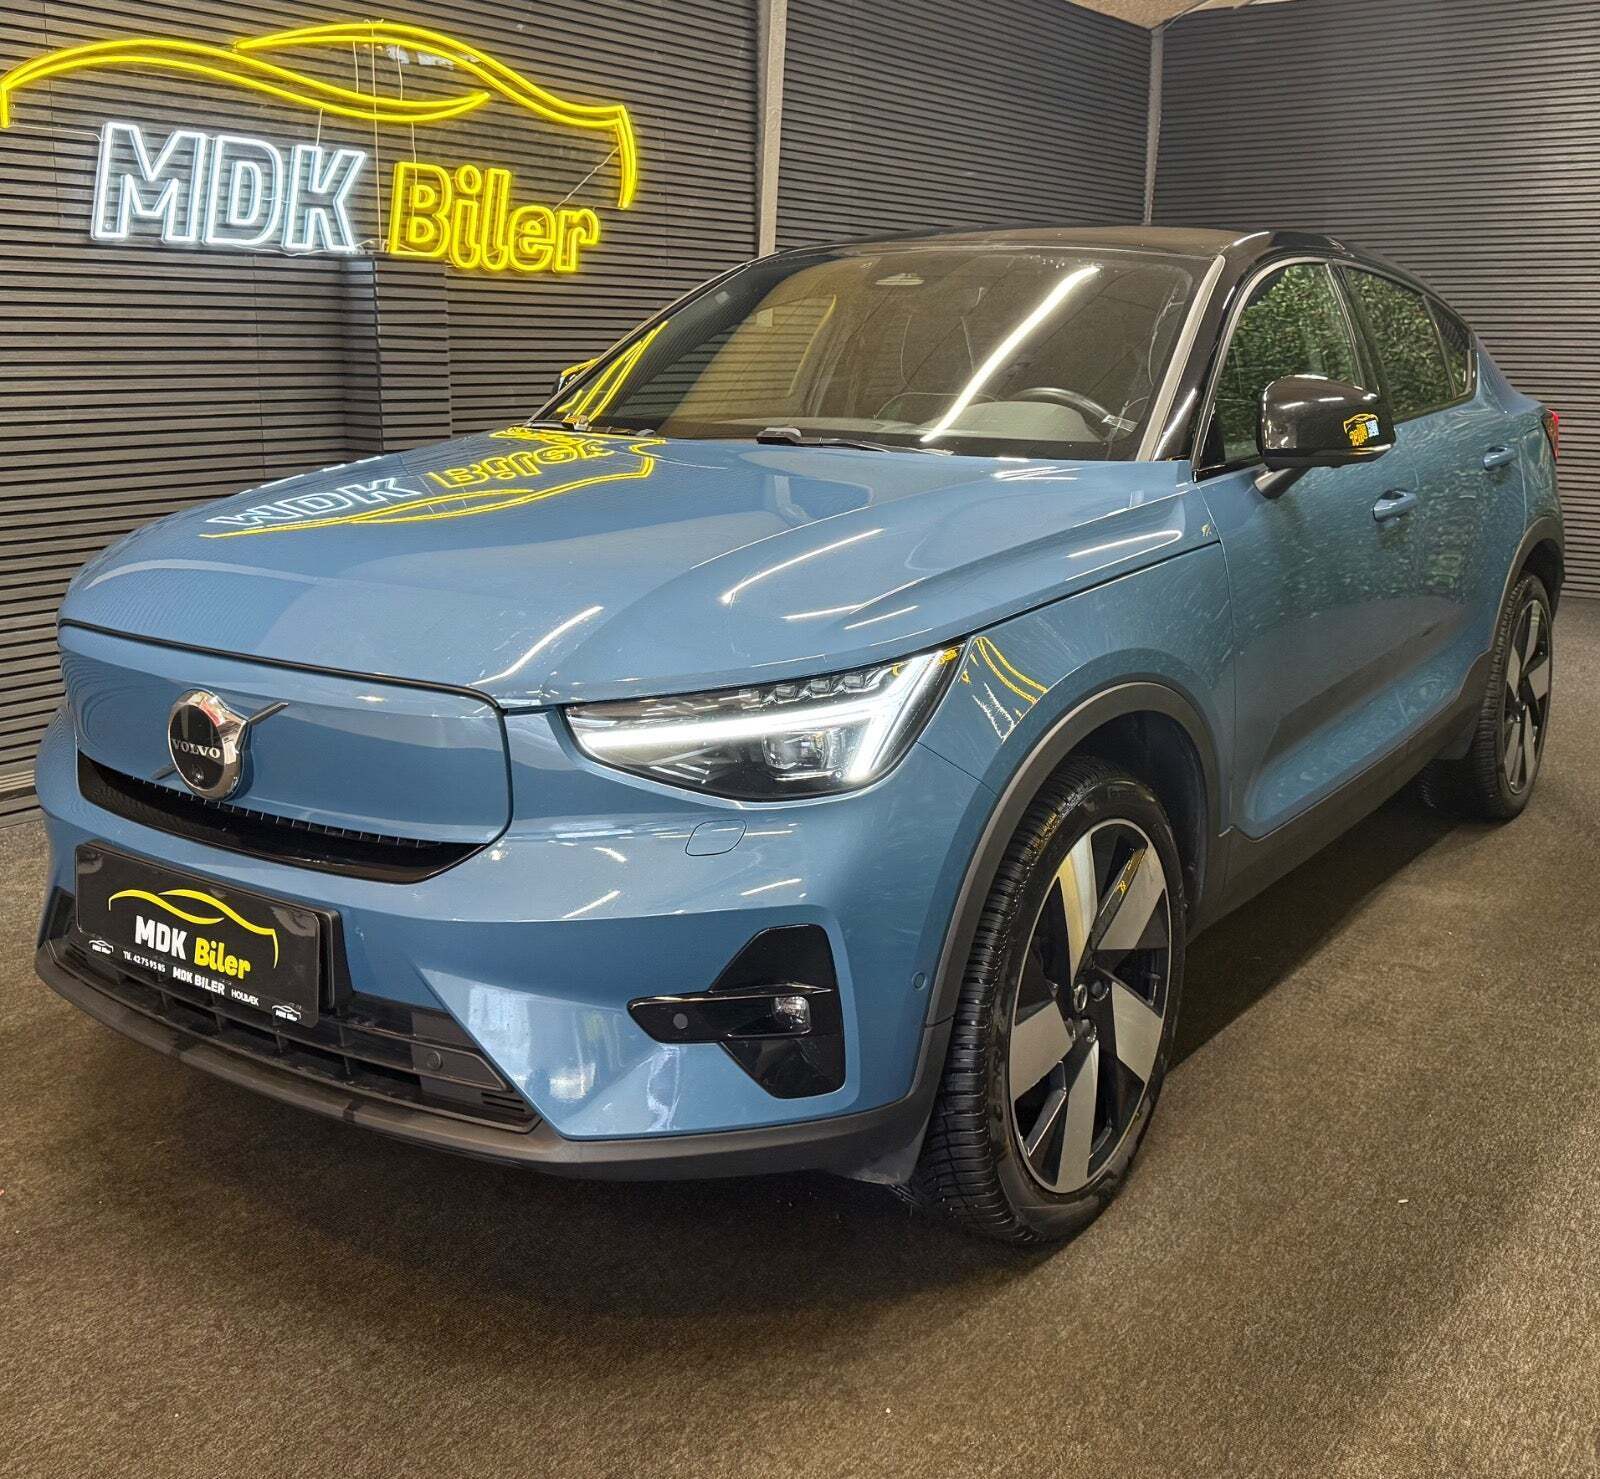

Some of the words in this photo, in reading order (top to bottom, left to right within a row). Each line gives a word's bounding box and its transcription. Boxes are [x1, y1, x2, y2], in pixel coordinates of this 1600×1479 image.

[91, 121, 368, 253] MDK
[389, 161, 600, 273] Biler
[172, 739, 220, 759] VOLVO
[135, 915, 187, 960] MDK
[194, 937, 251, 979] Biler
[172, 967, 193, 984] MDK
[194, 975, 225, 995] BILER
